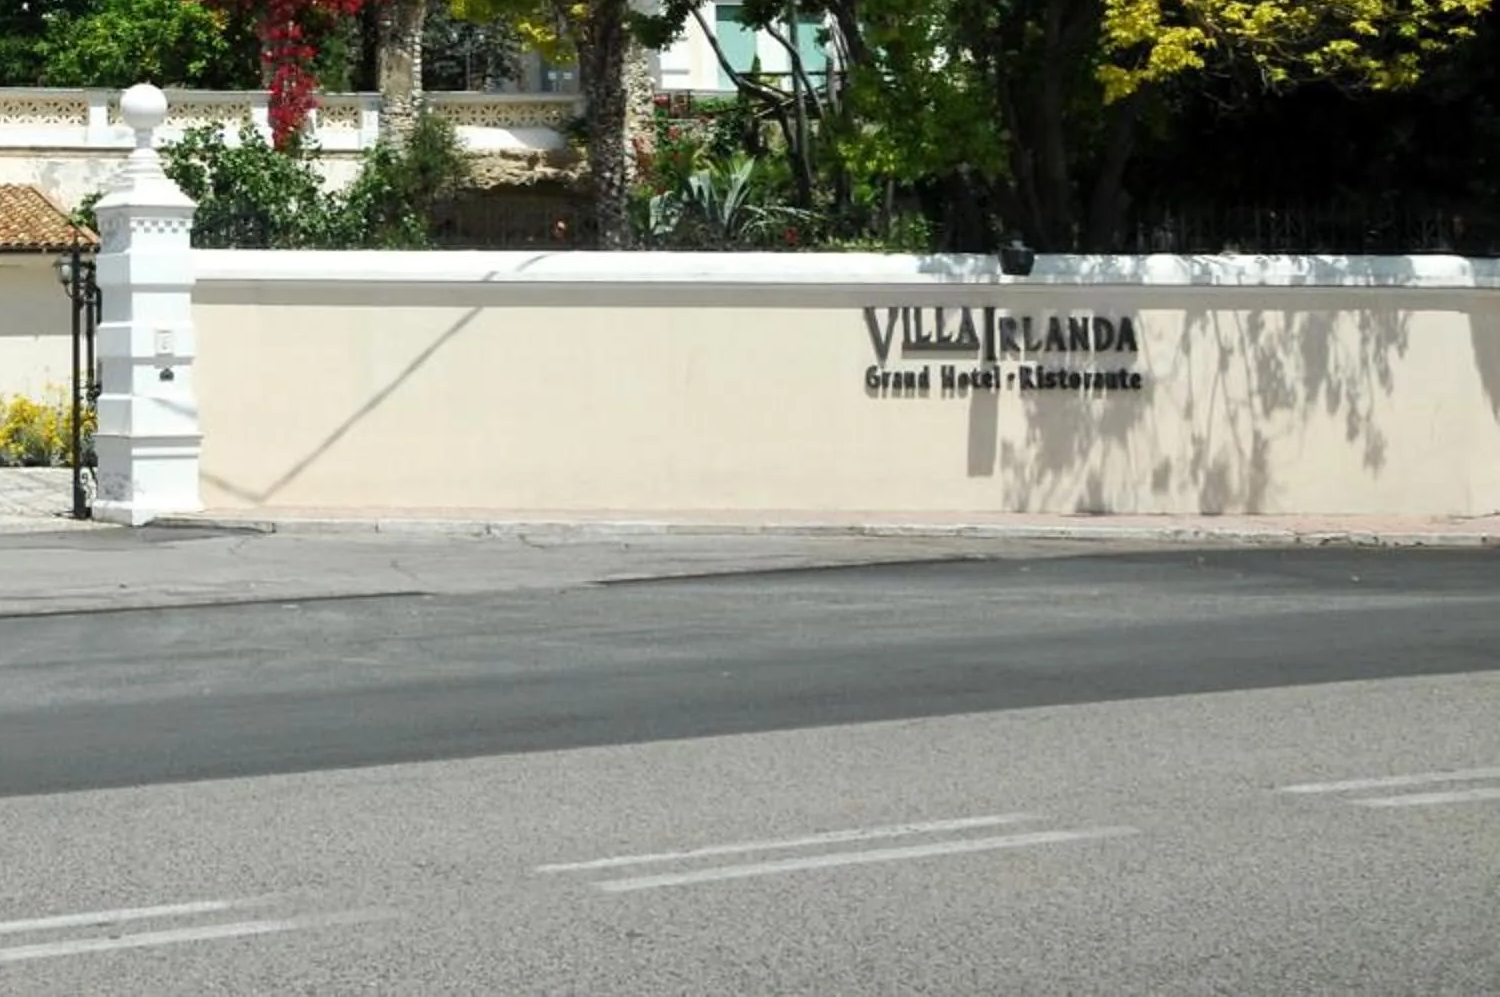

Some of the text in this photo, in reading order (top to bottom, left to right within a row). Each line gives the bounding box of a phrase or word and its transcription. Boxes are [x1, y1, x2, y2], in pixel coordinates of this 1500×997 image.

[862, 306, 1139, 364] VILLA IRLANDA
[865, 364, 1142, 391] Grand Hotel Ristorante
